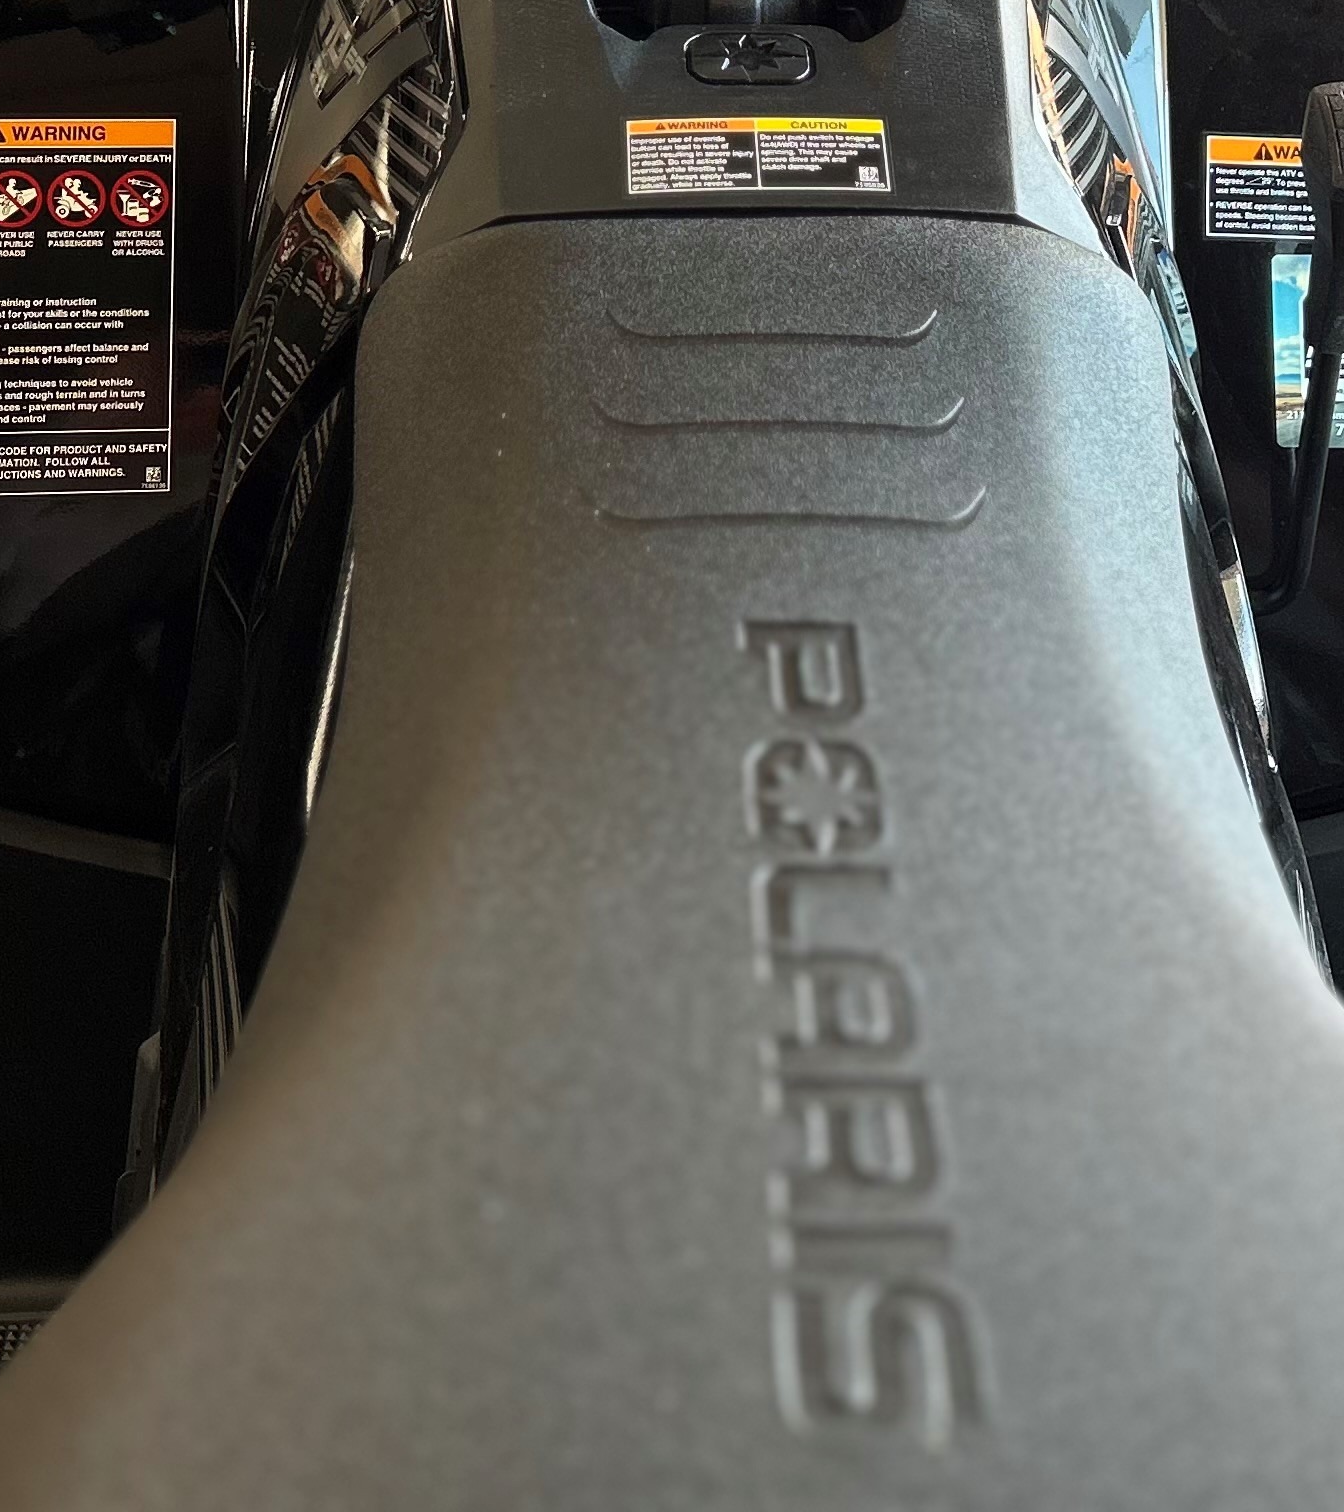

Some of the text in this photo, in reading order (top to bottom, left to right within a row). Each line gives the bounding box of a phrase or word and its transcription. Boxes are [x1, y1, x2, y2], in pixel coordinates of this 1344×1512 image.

[667, 121, 728, 130] WARNING
[790, 121, 848, 130] CAUTION
[12, 126, 106, 141] WARNING
[54, 155, 92, 163] SEVERE
[46, 298, 97, 306] instruction
[8, 310, 21, 318] for
[100, 309, 149, 317] conditions
[104, 320, 124, 328] with
[25, 392, 54, 401] rough
[56, 391, 87, 399] terrain
[89, 390, 107, 398] and
[12, 415, 46, 423] control
[53, 445, 102, 454] PRODUCT
[105, 445, 127, 453] AND
[129, 444, 167, 452] SAFETY
[45, 457, 89, 466] FOLLOW
[91, 457, 110, 465] ALL
[44, 470, 66, 478] AND
[68, 468, 126, 477] WARNINGS.
[738, 618, 998, 1454] POLARIS
